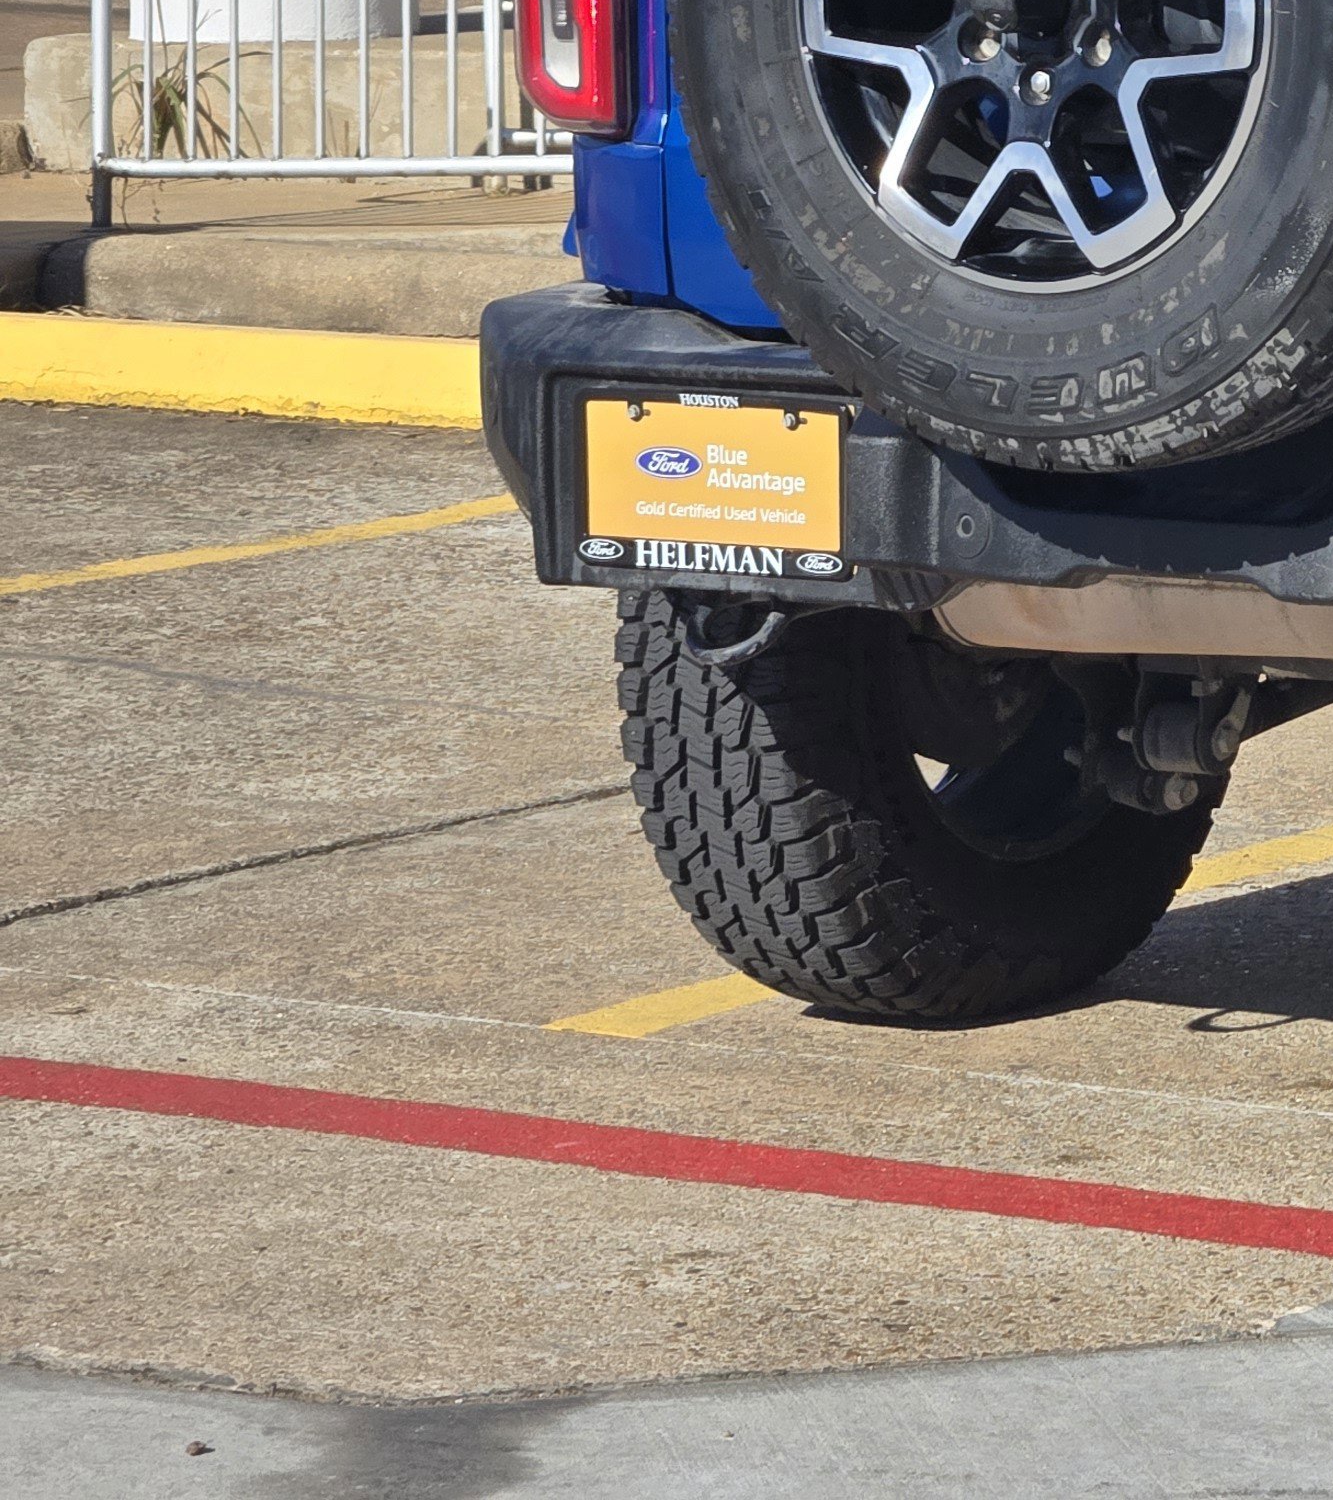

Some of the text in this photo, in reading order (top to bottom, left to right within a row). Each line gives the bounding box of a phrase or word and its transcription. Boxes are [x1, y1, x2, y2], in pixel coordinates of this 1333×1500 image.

[831, 302, 1223, 415] DUELER
[679, 393, 739, 408] HOUSTON
[646, 450, 691, 475] Ford
[706, 444, 748, 466] Blue
[706, 468, 806, 495] Advantage
[635, 500, 806, 524] Gold Certified Used Vehicle
[585, 541, 618, 557] Ford
[634, 539, 784, 576] HELFMAN
[802, 555, 837, 573] Ford
